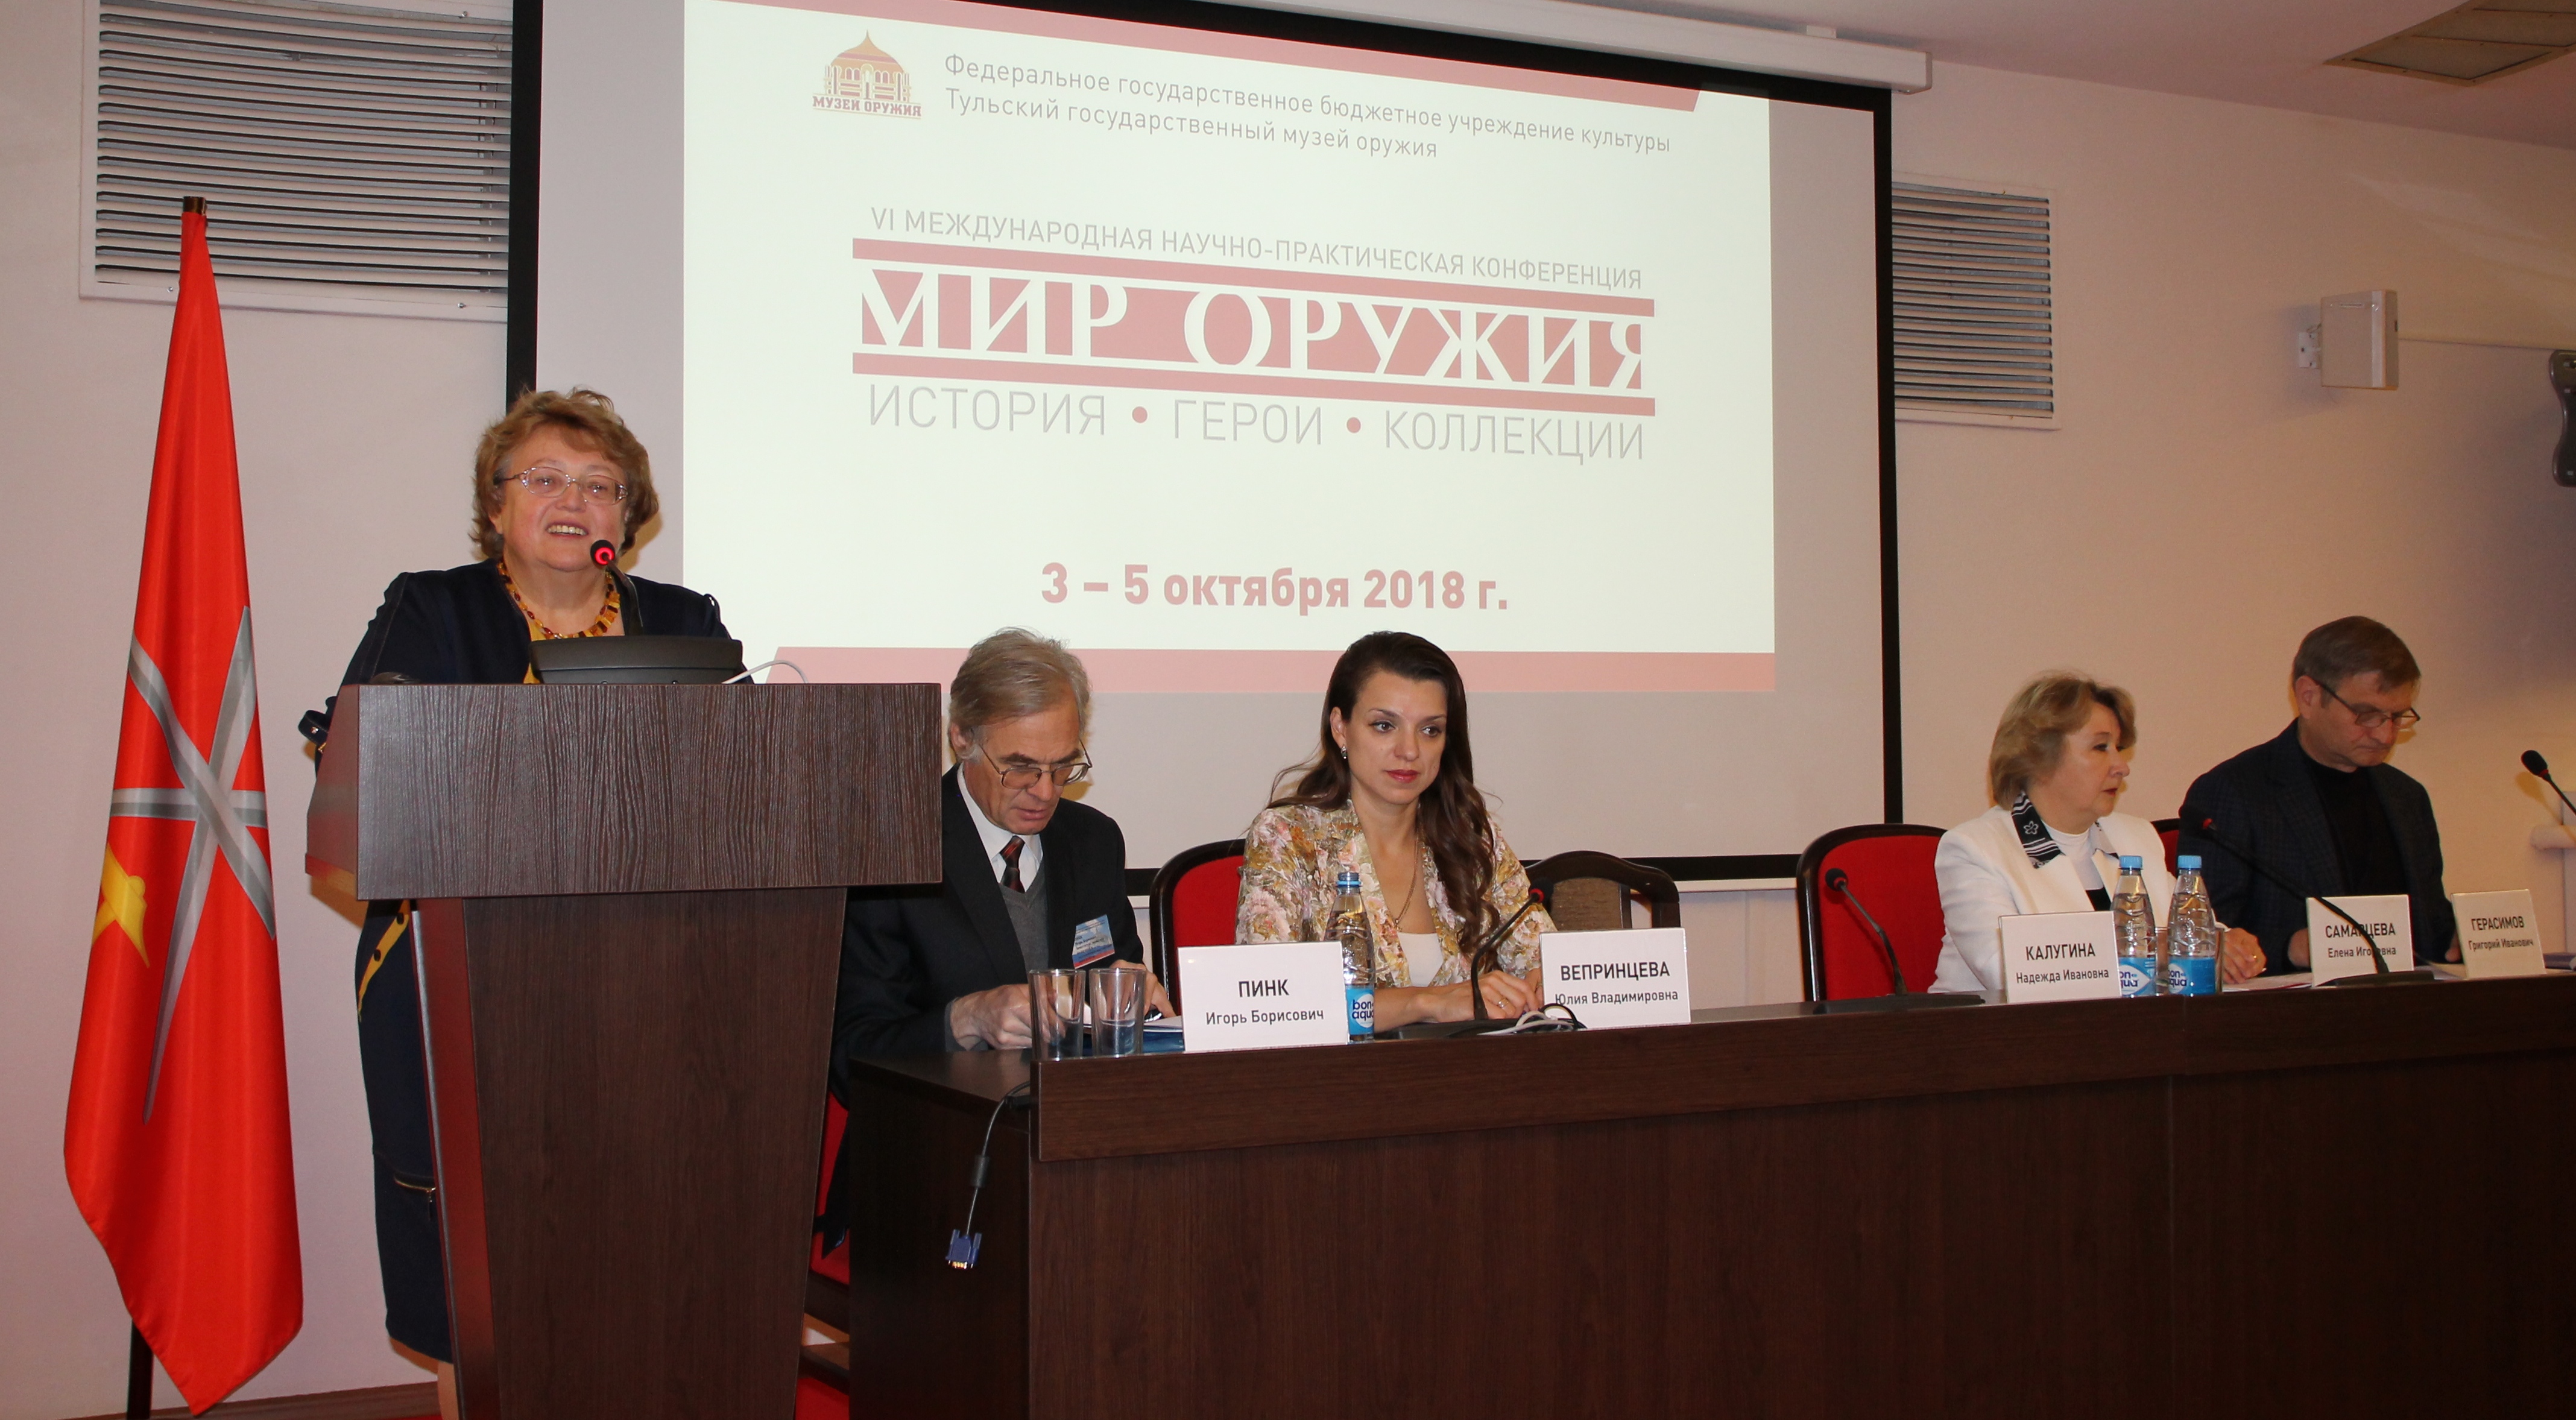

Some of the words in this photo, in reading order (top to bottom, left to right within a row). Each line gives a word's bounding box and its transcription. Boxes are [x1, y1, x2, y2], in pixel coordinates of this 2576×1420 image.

[864, 101, 922, 117] ОРУЖИЯ
[945, 53, 1110, 92] Федеральное
[1119, 77, 1313, 113] государственное
[1320, 94, 1442, 127] бюджетное
[1448, 113, 1574, 142] учреждение
[1581, 127, 1671, 154] культуры
[945, 87, 1059, 120] Тульский
[1068, 105, 1275, 142] государственный
[1283, 124, 1349, 150] музей
[1357, 136, 1437, 158] оружия
[870, 206, 894, 232] VI
[905, 209, 1152, 251] МЕЖДУНАРОДНАЯ
[1163, 230, 1463, 276] НАУЧНО-ПРАКТИЧЕСКАЯ
[1471, 255, 1642, 291] КОНФЕРЕНЦИЯ
[859, 268, 1128, 358] МИР
[1183, 291, 1647, 391] ОРУЖИЯ
[870, 383, 1105, 435] ИСТОРИЯ
[1174, 399, 1322, 445] ГЕРОИ
[1386, 409, 1643, 465] КОЛЛЕКЦИИ
[1041, 562, 1068, 604] 3
[1125, 564, 1149, 605] 5
[1164, 567, 1349, 616] октября
[1363, 569, 1465, 609] 2018
[1479, 579, 1507, 610] г.
[2471, 916, 2525, 931] ГЕРАСИМОВ
[2025, 942, 2096, 961] КАЛУГИНА
[2328, 947, 2353, 958] Елена
[2468, 939, 2501, 952] Григорий
[2501, 938, 2534, 948] Иванович
[1561, 961, 1670, 981] ВЕПРИНЦЕВА
[2016, 972, 2061, 985] Надежда
[2063, 969, 2109, 982] Ивановна
[2120, 970, 2131, 979] on
[1239, 979, 1290, 998] ПИНК
[1555, 993, 1588, 1006] Юлия
[1591, 991, 1678, 1006] Владимировна
[1206, 1012, 1248, 1027] Игорь
[1251, 1009, 1324, 1024] Борисович
